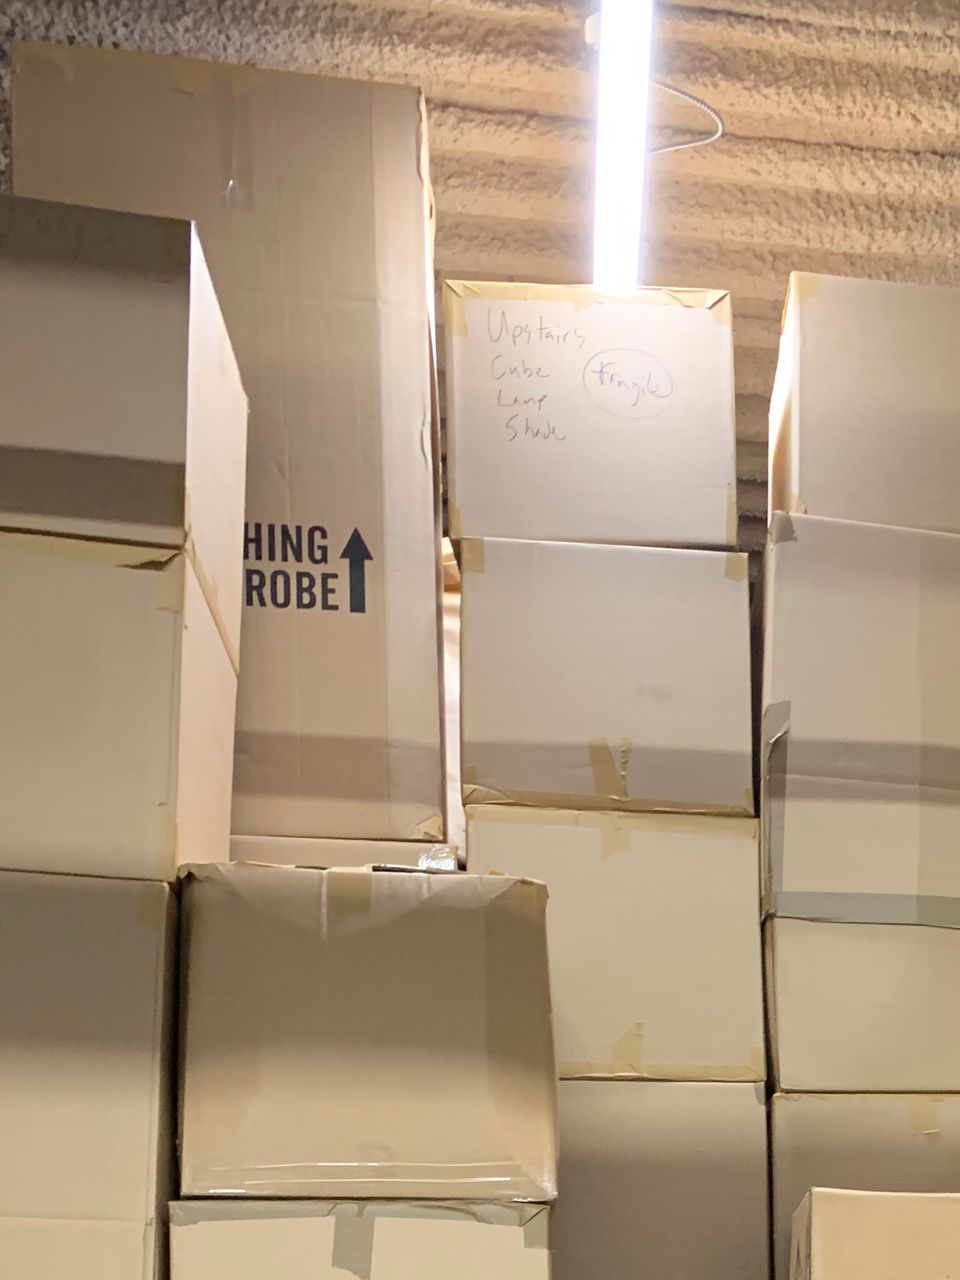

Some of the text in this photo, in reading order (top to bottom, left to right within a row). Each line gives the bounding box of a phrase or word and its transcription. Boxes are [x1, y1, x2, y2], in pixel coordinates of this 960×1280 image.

[487, 308, 586, 349] Upstairs
[491, 354, 550, 379] Cube
[245, 569, 339, 610] ROBE
